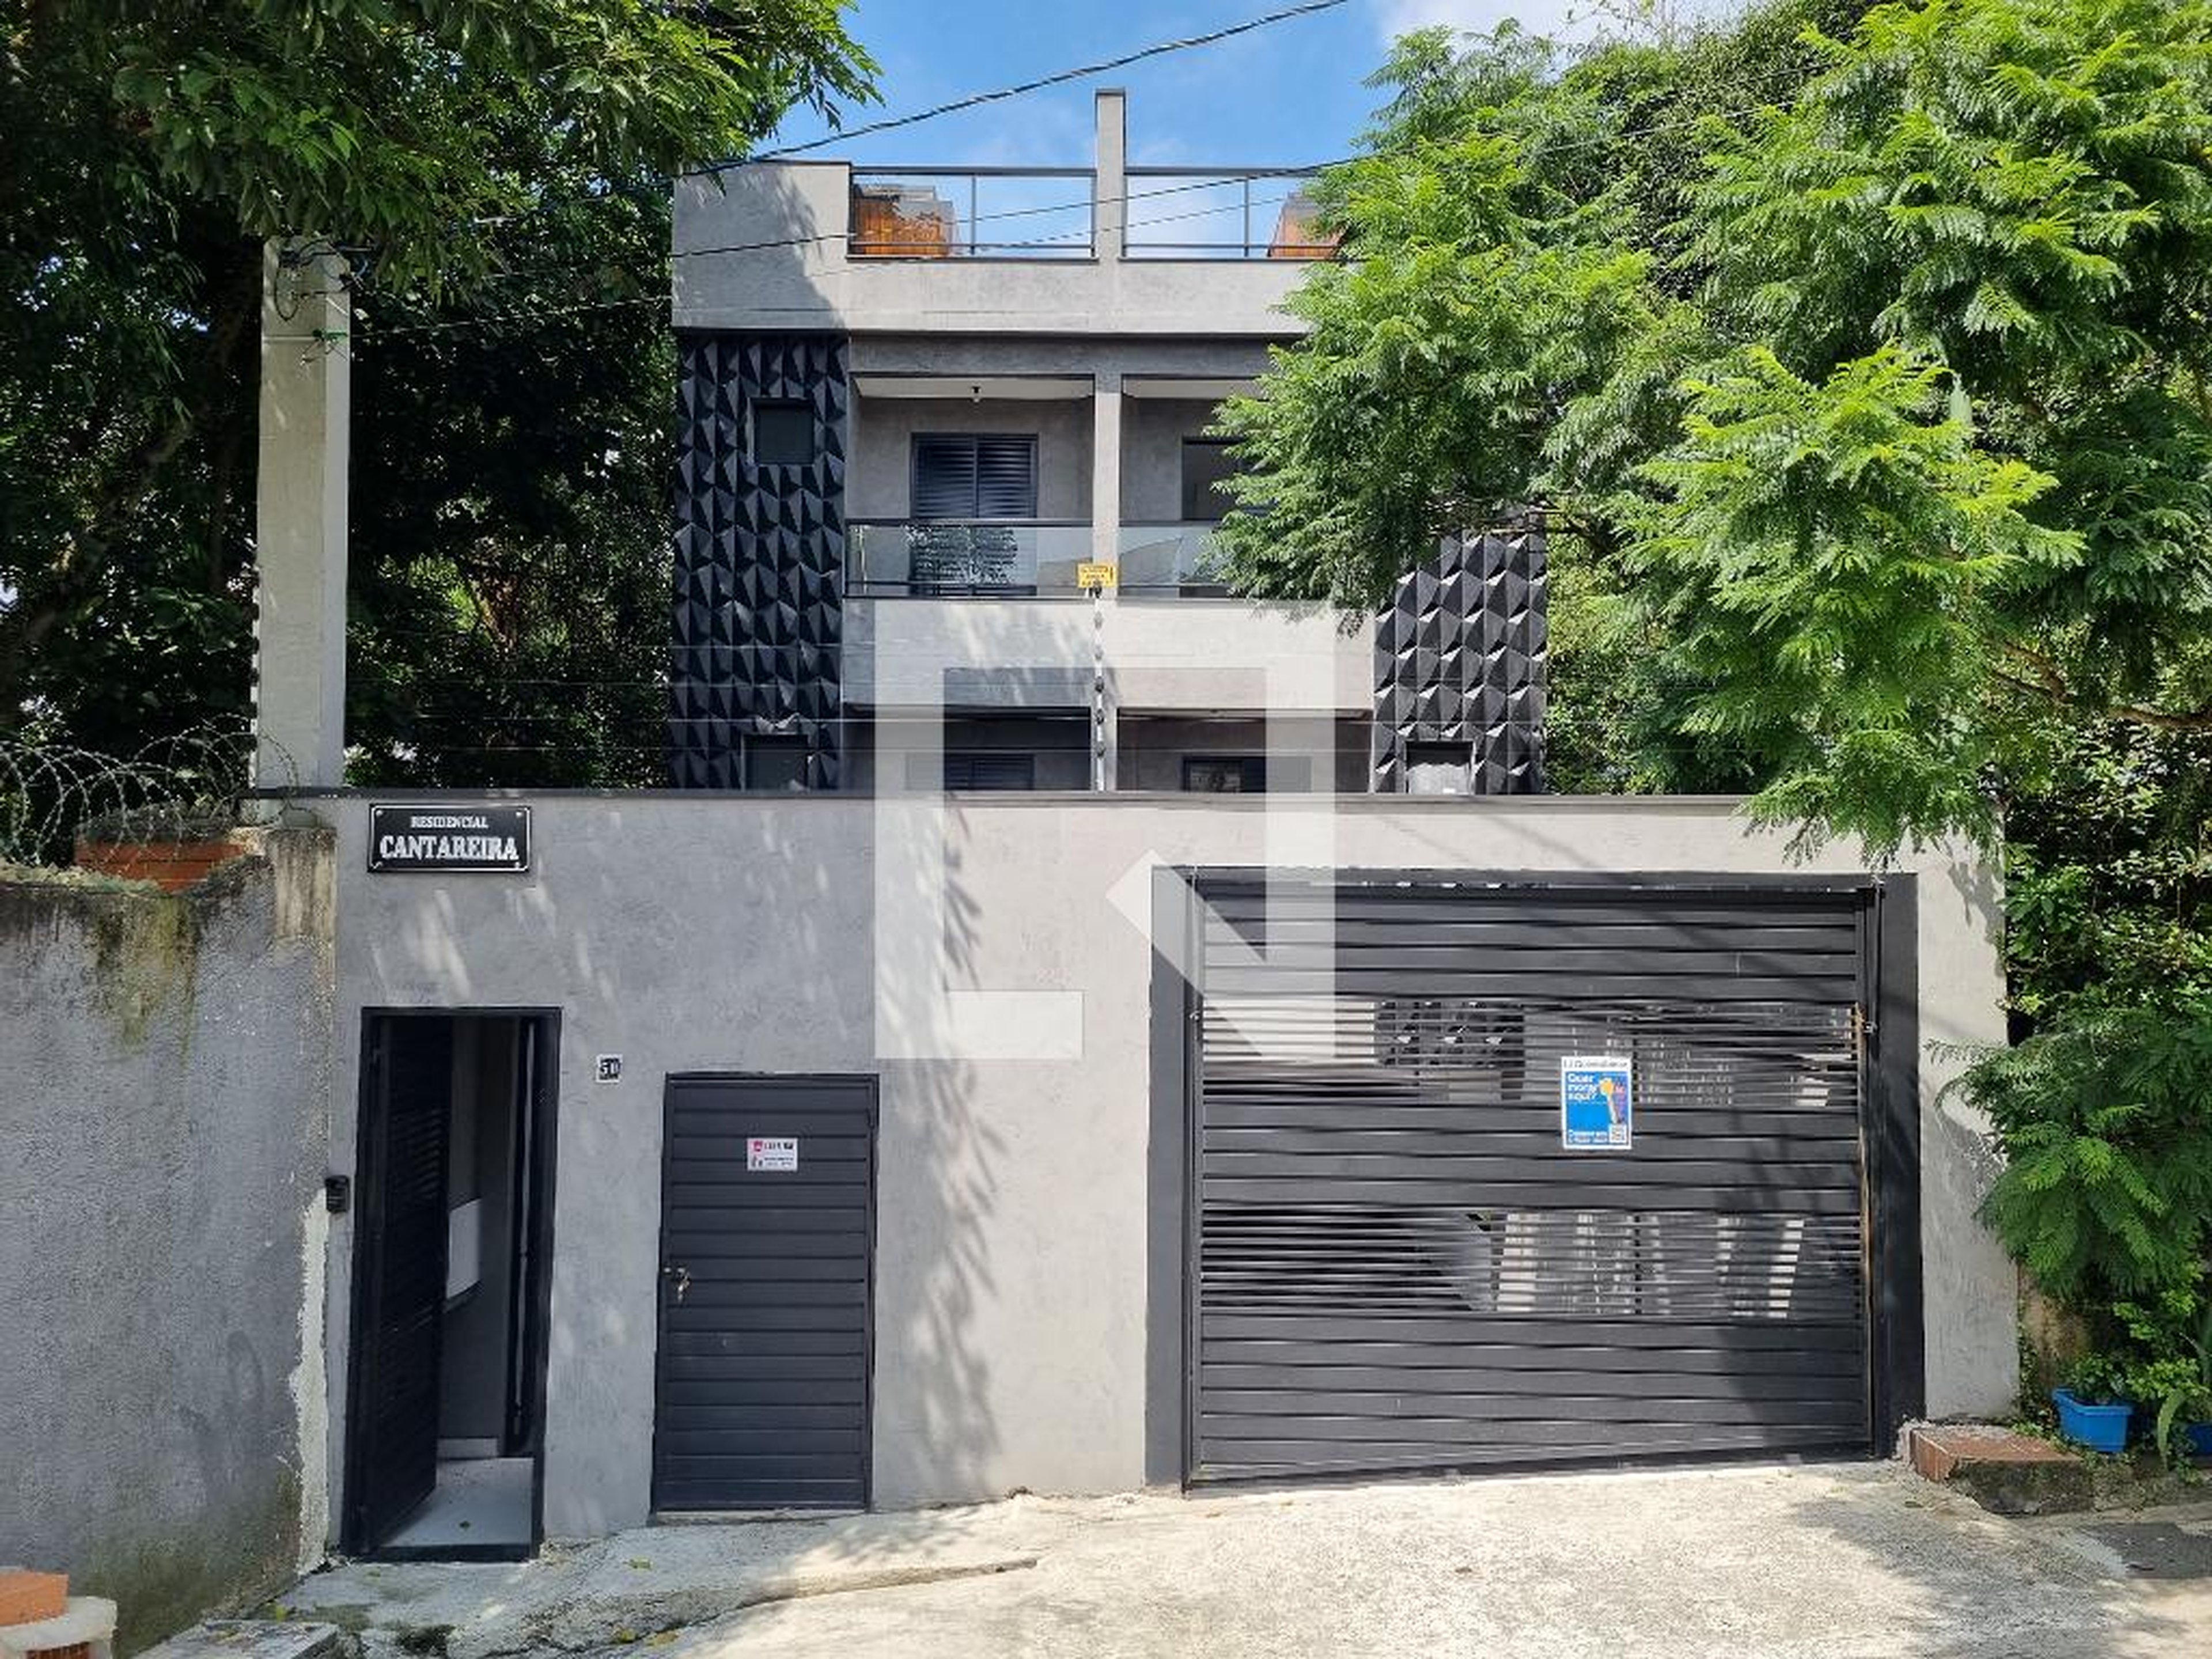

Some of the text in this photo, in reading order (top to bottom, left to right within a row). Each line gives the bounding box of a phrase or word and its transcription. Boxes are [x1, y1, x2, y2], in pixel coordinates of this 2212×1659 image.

[411, 816, 488, 828] RESIDENCIAL
[379, 835, 519, 860] CANTAREIRA
[1567, 1073, 1594, 1083] Quer
